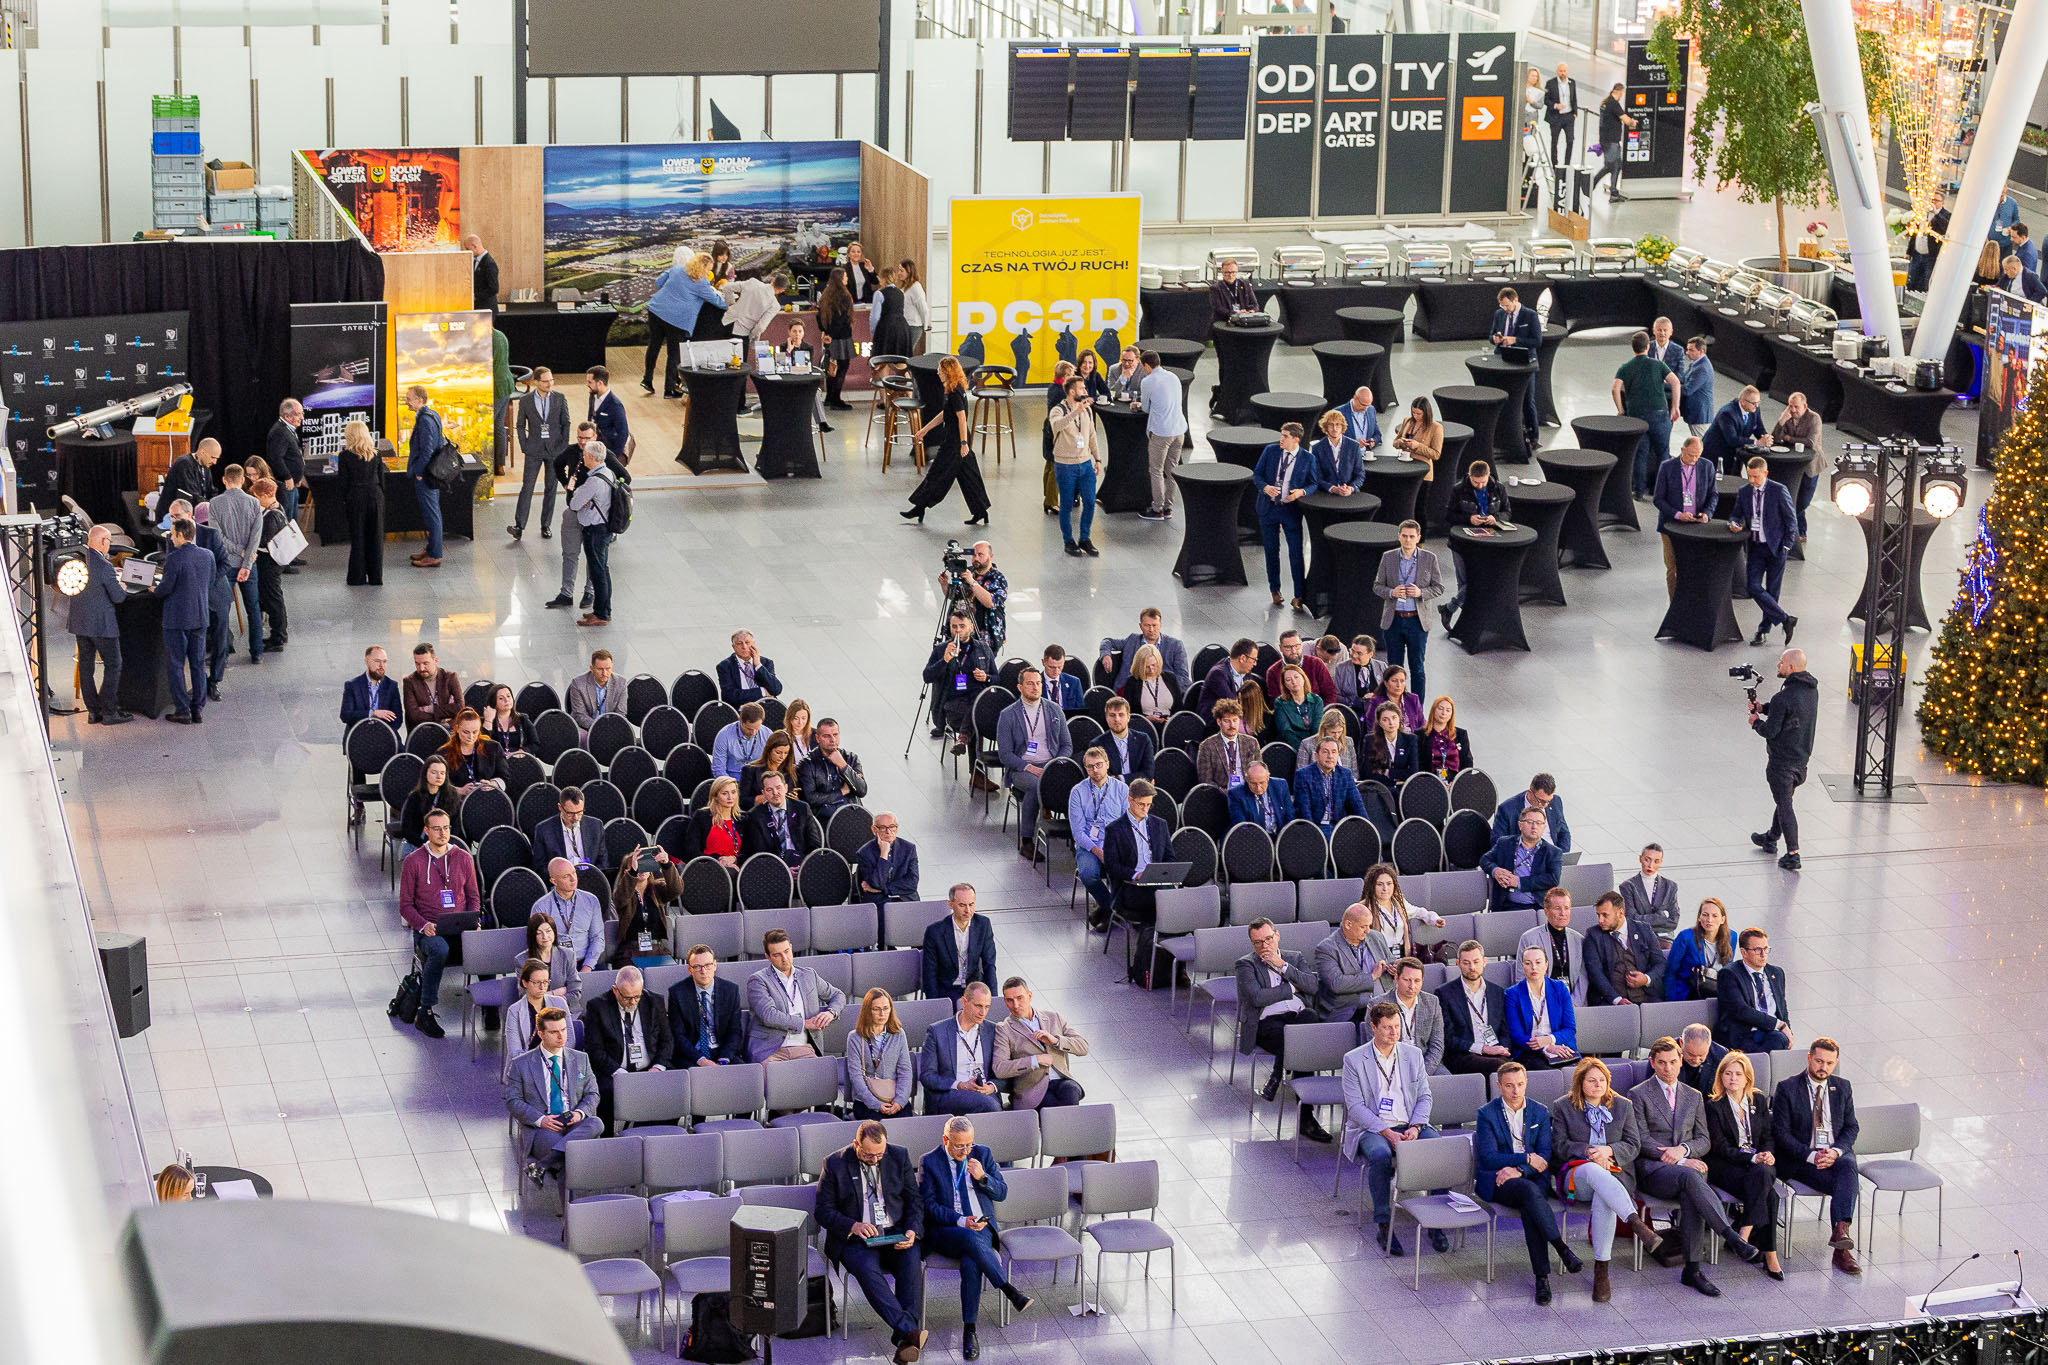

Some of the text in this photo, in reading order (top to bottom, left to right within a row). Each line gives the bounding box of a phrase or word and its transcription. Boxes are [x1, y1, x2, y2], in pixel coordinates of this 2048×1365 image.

[1257, 62, 1446, 94] OD LO TY
[1257, 110, 1444, 134] DEP ART URE
[1325, 134, 1376, 148] GATES
[662, 157, 751, 167] LOWER DOLNY
[331, 165, 423, 175] LOWER DOLNY
[663, 166, 696, 175] SILESIA
[330, 174, 367, 183] SILESIA
[984, 249, 1057, 258] TECHNOLOGIA
[961, 258, 1129, 274] CZAS NA TWÓJ RUCH!
[957, 298, 1130, 336] DC3D
[302, 418, 320, 426] NEW
